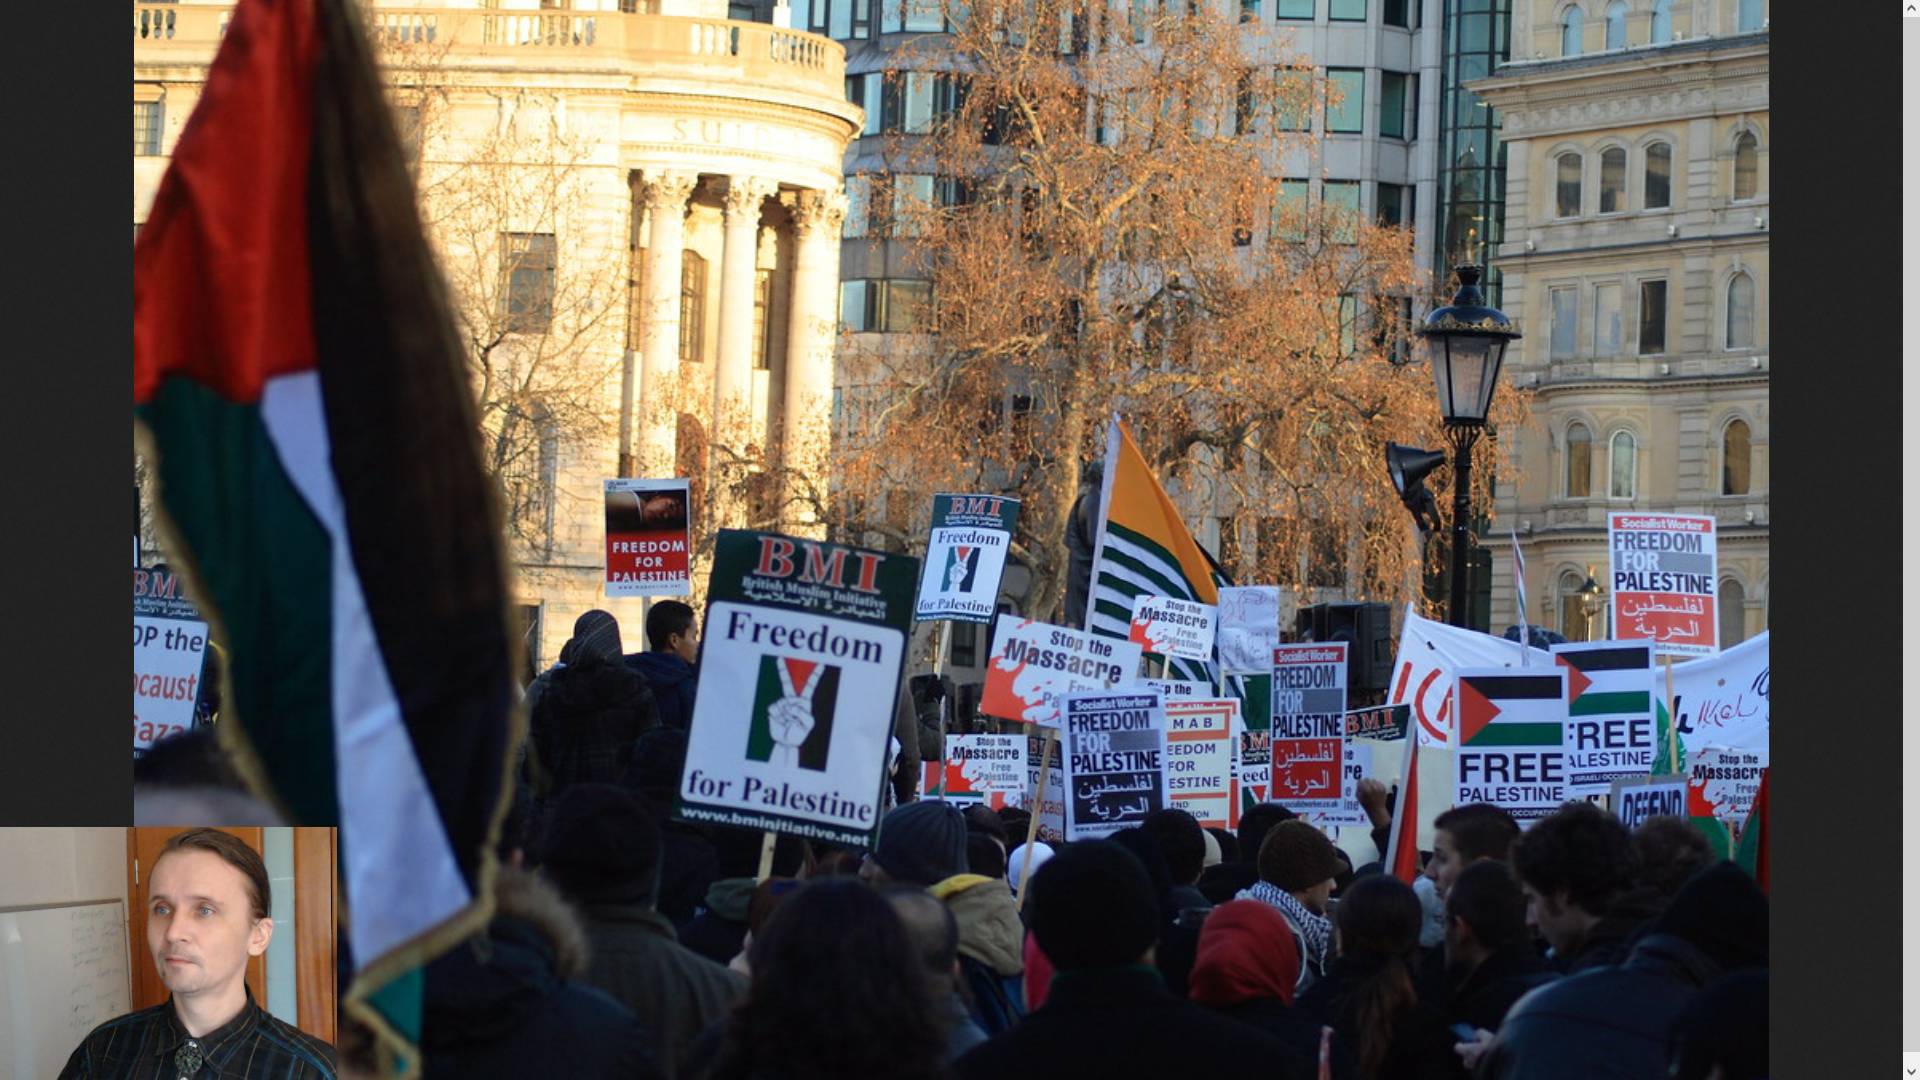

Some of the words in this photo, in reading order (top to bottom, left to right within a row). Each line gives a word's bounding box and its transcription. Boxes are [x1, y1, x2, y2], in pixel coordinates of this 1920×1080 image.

[948, 497, 1004, 517] BMI
[1621, 518, 1666, 530] Socialist
[1667, 520, 1704, 531] Worker
[612, 541, 685, 553] FREEDOM
[938, 530, 1000, 546] Freedom
[1613, 531, 1702, 553] FREEDOM
[635, 557, 663, 567] FOR
[753, 536, 886, 595] BMI
[1621, 552, 1660, 571] FOR
[613, 570, 686, 583] PALESTINE
[1615, 571, 1714, 595] PALESTINE
[742, 576, 784, 592] British
[786, 582, 832, 600] Muslim
[834, 589, 888, 609] Initiative
[920, 599, 935, 610] for
[938, 599, 992, 613] Palestine
[1165, 600, 1186, 611] Stop
[1187, 603, 1202, 614] the
[1622, 595, 1704, 616] لفلسطين
[1139, 606, 1208, 630] Massacre
[165, 627, 204, 652] the
[726, 610, 883, 664] Freedom
[1176, 627, 1198, 640] Free
[1634, 617, 1700, 641] الحرية
[1050, 630, 1084, 650] Stop
[1089, 639, 1112, 657] the
[1161, 634, 1204, 651] Palestine
[1003, 637, 1122, 684] Massacre
[1279, 650, 1312, 662] Socialist
[1313, 649, 1339, 661] Worker
[1273, 665, 1336, 689] FREEDOM
[1075, 699, 1116, 712] Socialist
[1118, 697, 1151, 708] Worker
[1280, 690, 1303, 714] FOR
[1069, 710, 1149, 733] FREEDOM
[1272, 714, 1342, 738] PALESTINE
[1346, 708, 1396, 734] BMI
[976, 737, 996, 747] Stop
[998, 737, 1012, 746] the
[1077, 732, 1111, 752] FOR
[952, 746, 1020, 760] Massacre
[1071, 752, 1161, 773] PALESTINE
[1276, 742, 1335, 769] لفلسطين
[1719, 754, 1740, 765] Stop
[1743, 753, 1758, 764] the
[978, 771, 1019, 781] Palestine
[991, 762, 1012, 772] Free
[1168, 761, 1195, 772] FOR
[1459, 753, 1564, 783] FREE
[1078, 773, 1153, 799] لفلسطين
[1283, 770, 1330, 796] الحرية
[688, 769, 732, 799] for
[742, 776, 873, 823] Palestine
[1460, 786, 1564, 802] PALESTINE
[1090, 797, 1150, 820] الحرية
[680, 806, 870, 848] www.bminitiative.net
